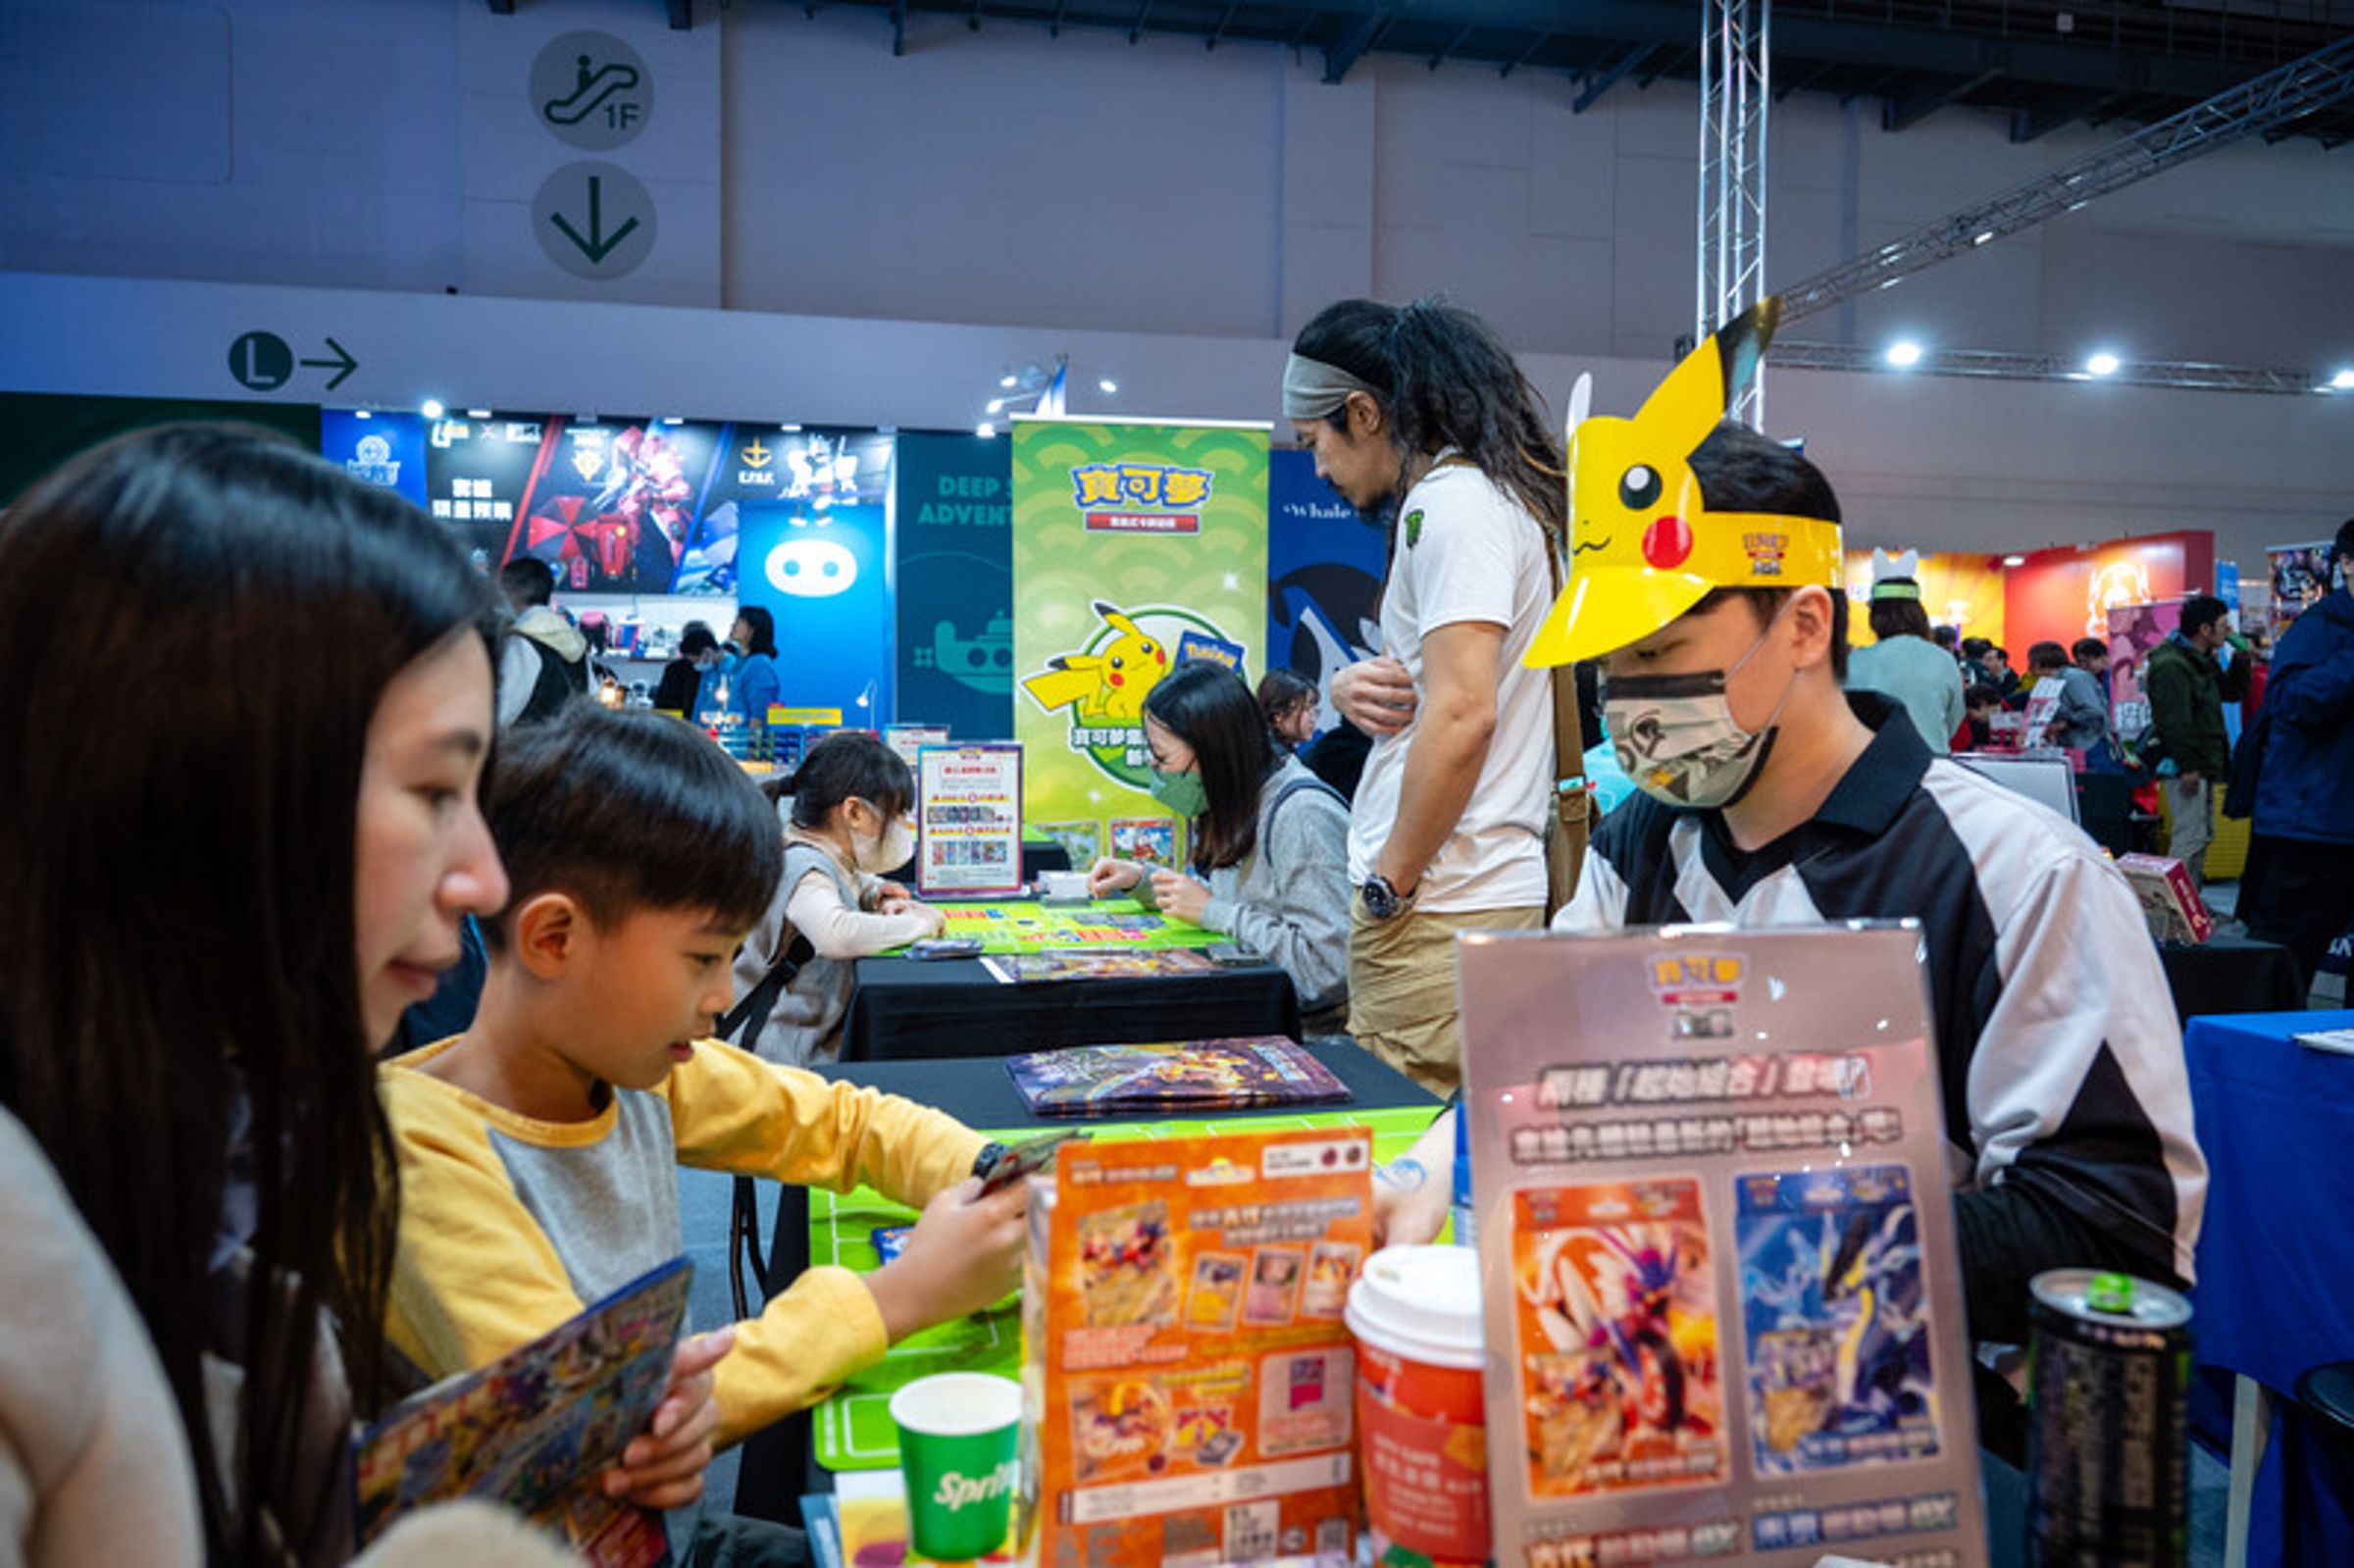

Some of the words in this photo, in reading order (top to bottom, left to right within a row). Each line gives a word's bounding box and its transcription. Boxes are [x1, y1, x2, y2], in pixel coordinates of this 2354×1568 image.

[604, 103, 640, 129] 1F
[245, 339, 276, 383] L
[939, 476, 999, 497] DEEP
[1075, 466, 1210, 507] 寶可夢
[918, 502, 1012, 526] ADVEN
